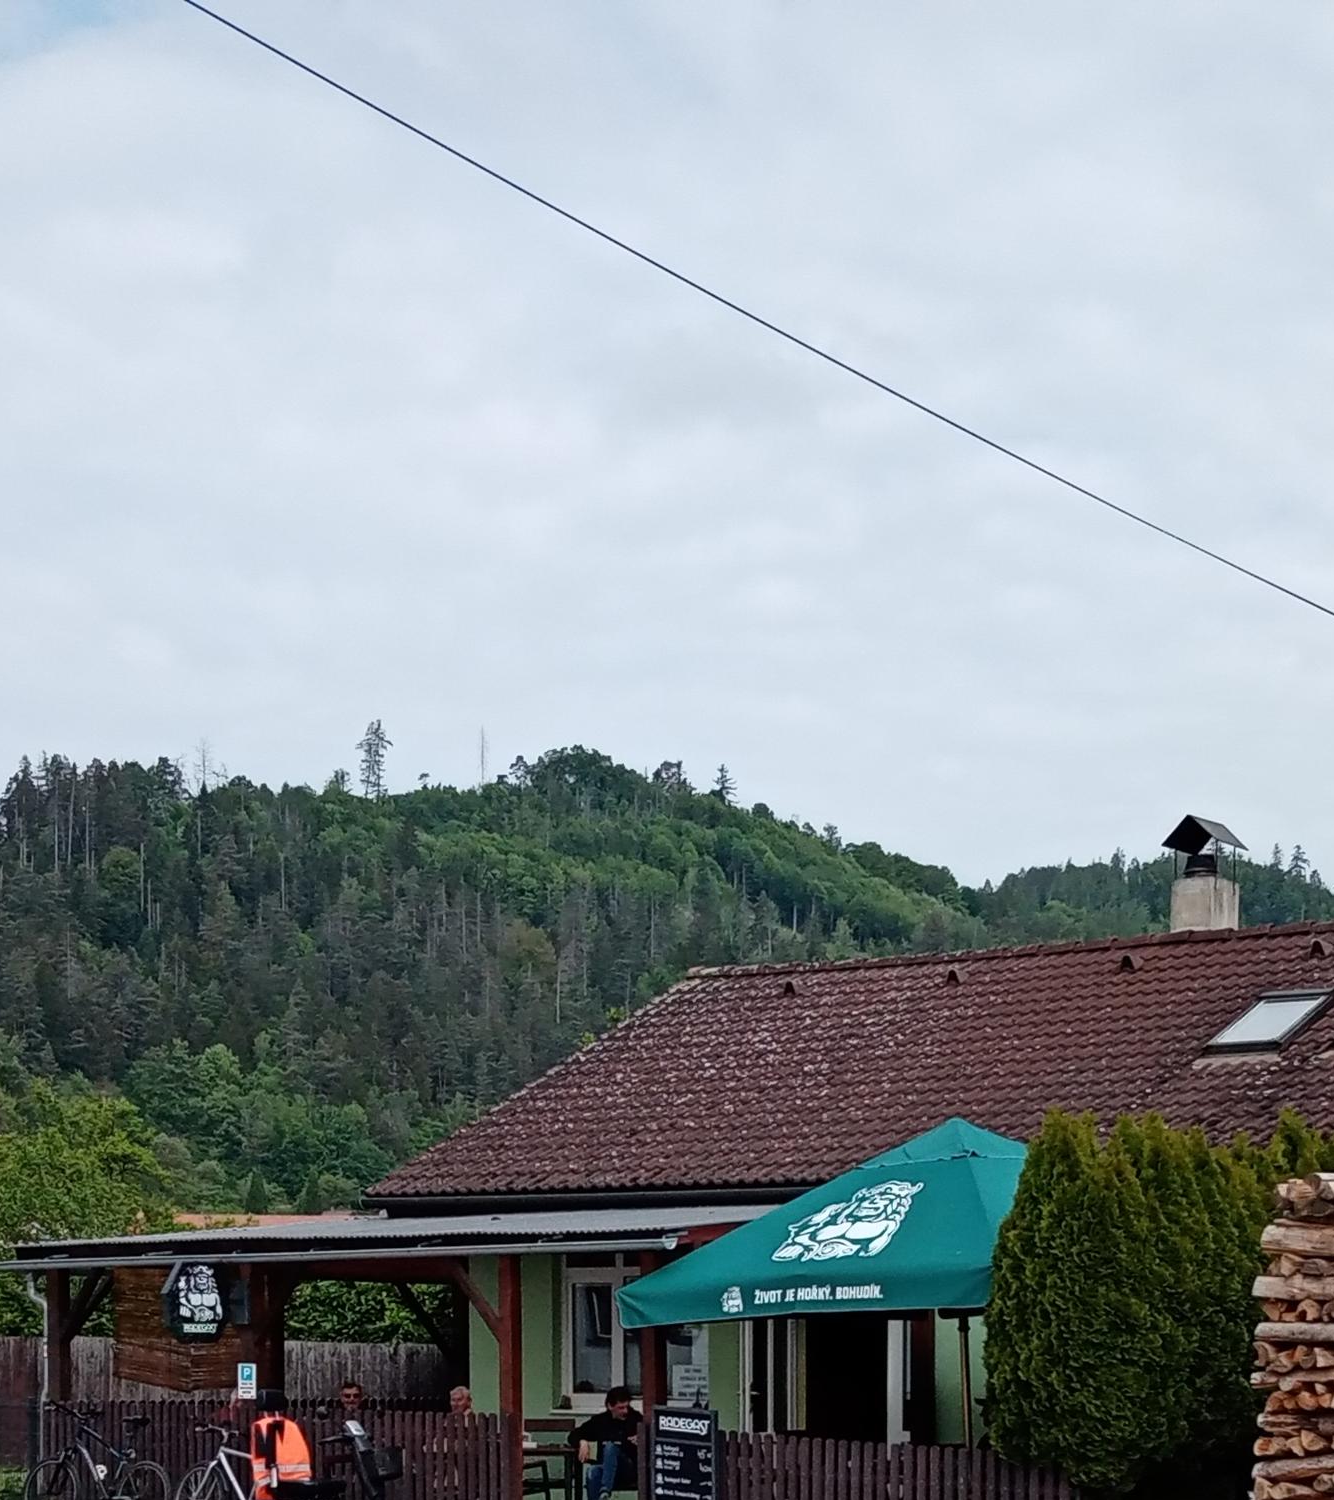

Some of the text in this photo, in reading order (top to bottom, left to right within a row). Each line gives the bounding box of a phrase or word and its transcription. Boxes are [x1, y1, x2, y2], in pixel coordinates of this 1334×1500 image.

[754, 1283, 883, 1304] ŽIVOT JE HOŘKÝ. BOHUDÍK.
[243, 1367, 251, 1379] P
[659, 1415, 710, 1436] RADEGAST
